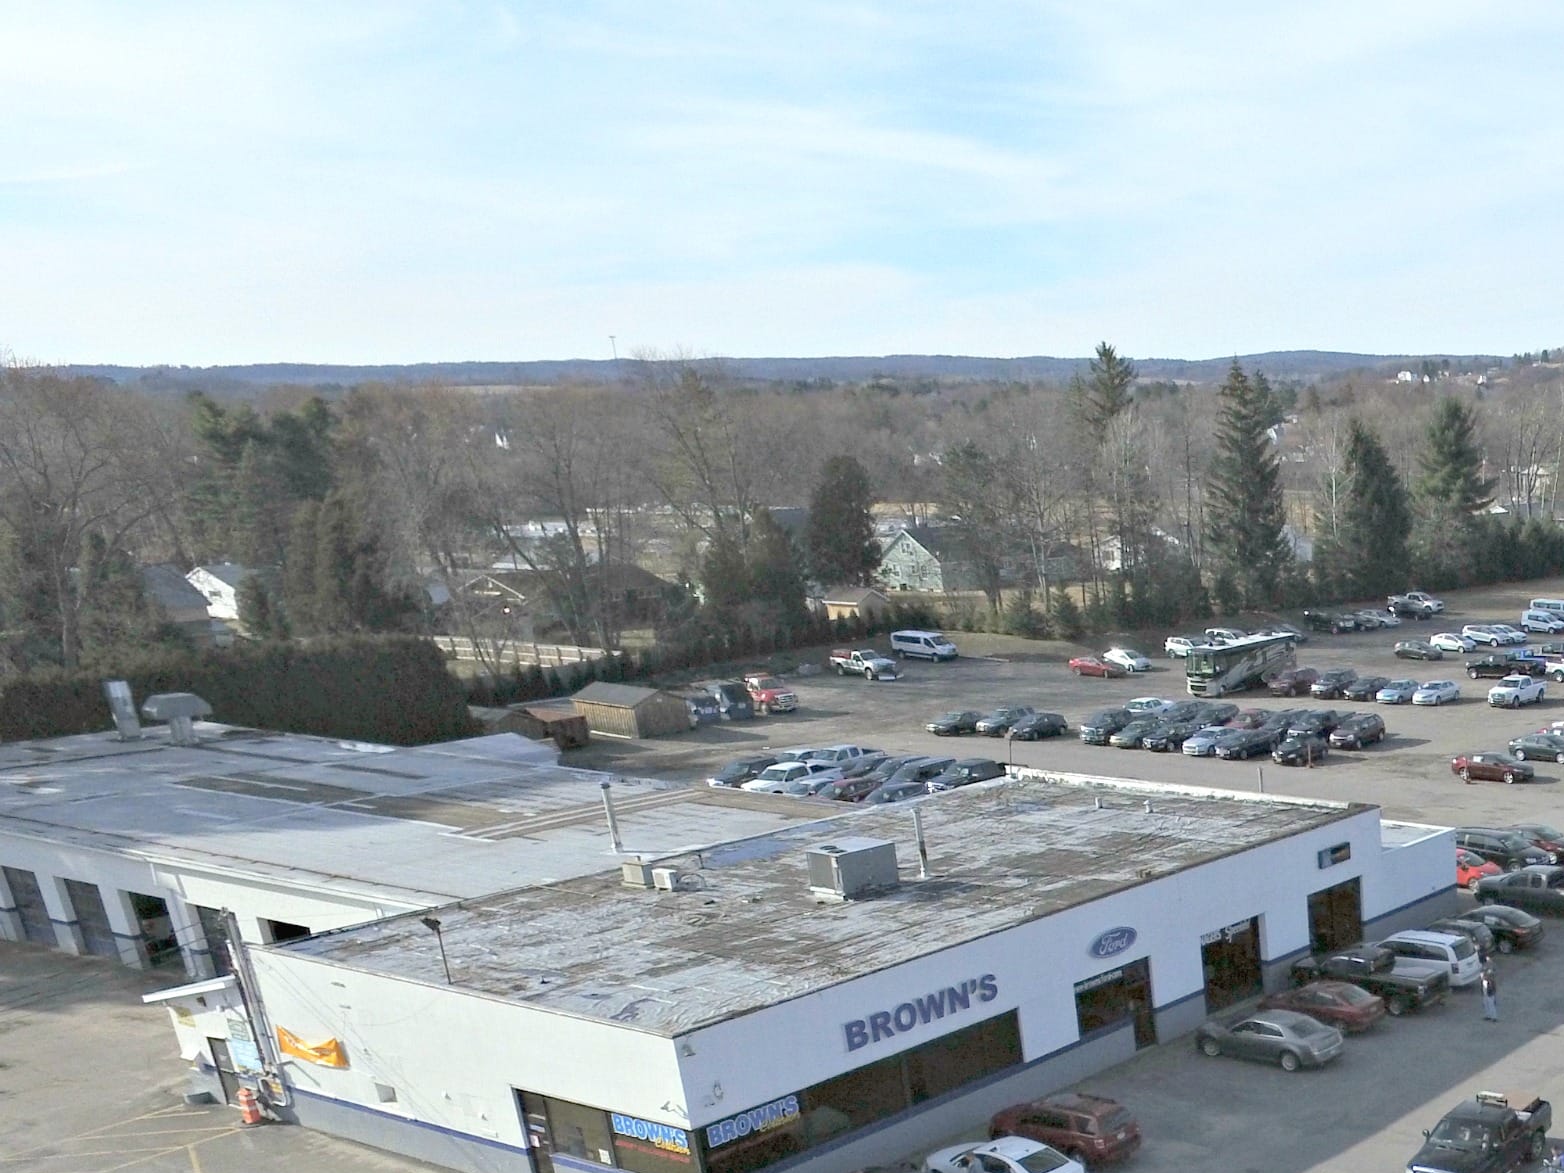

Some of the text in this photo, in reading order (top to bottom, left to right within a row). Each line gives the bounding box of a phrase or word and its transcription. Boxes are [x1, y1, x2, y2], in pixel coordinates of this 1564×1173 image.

[1099, 930, 1129, 956] Ford
[843, 973, 999, 1052] BROWN'S
[611, 1112, 689, 1149] BROWN'S
[706, 1095, 800, 1148] BROWN'S
